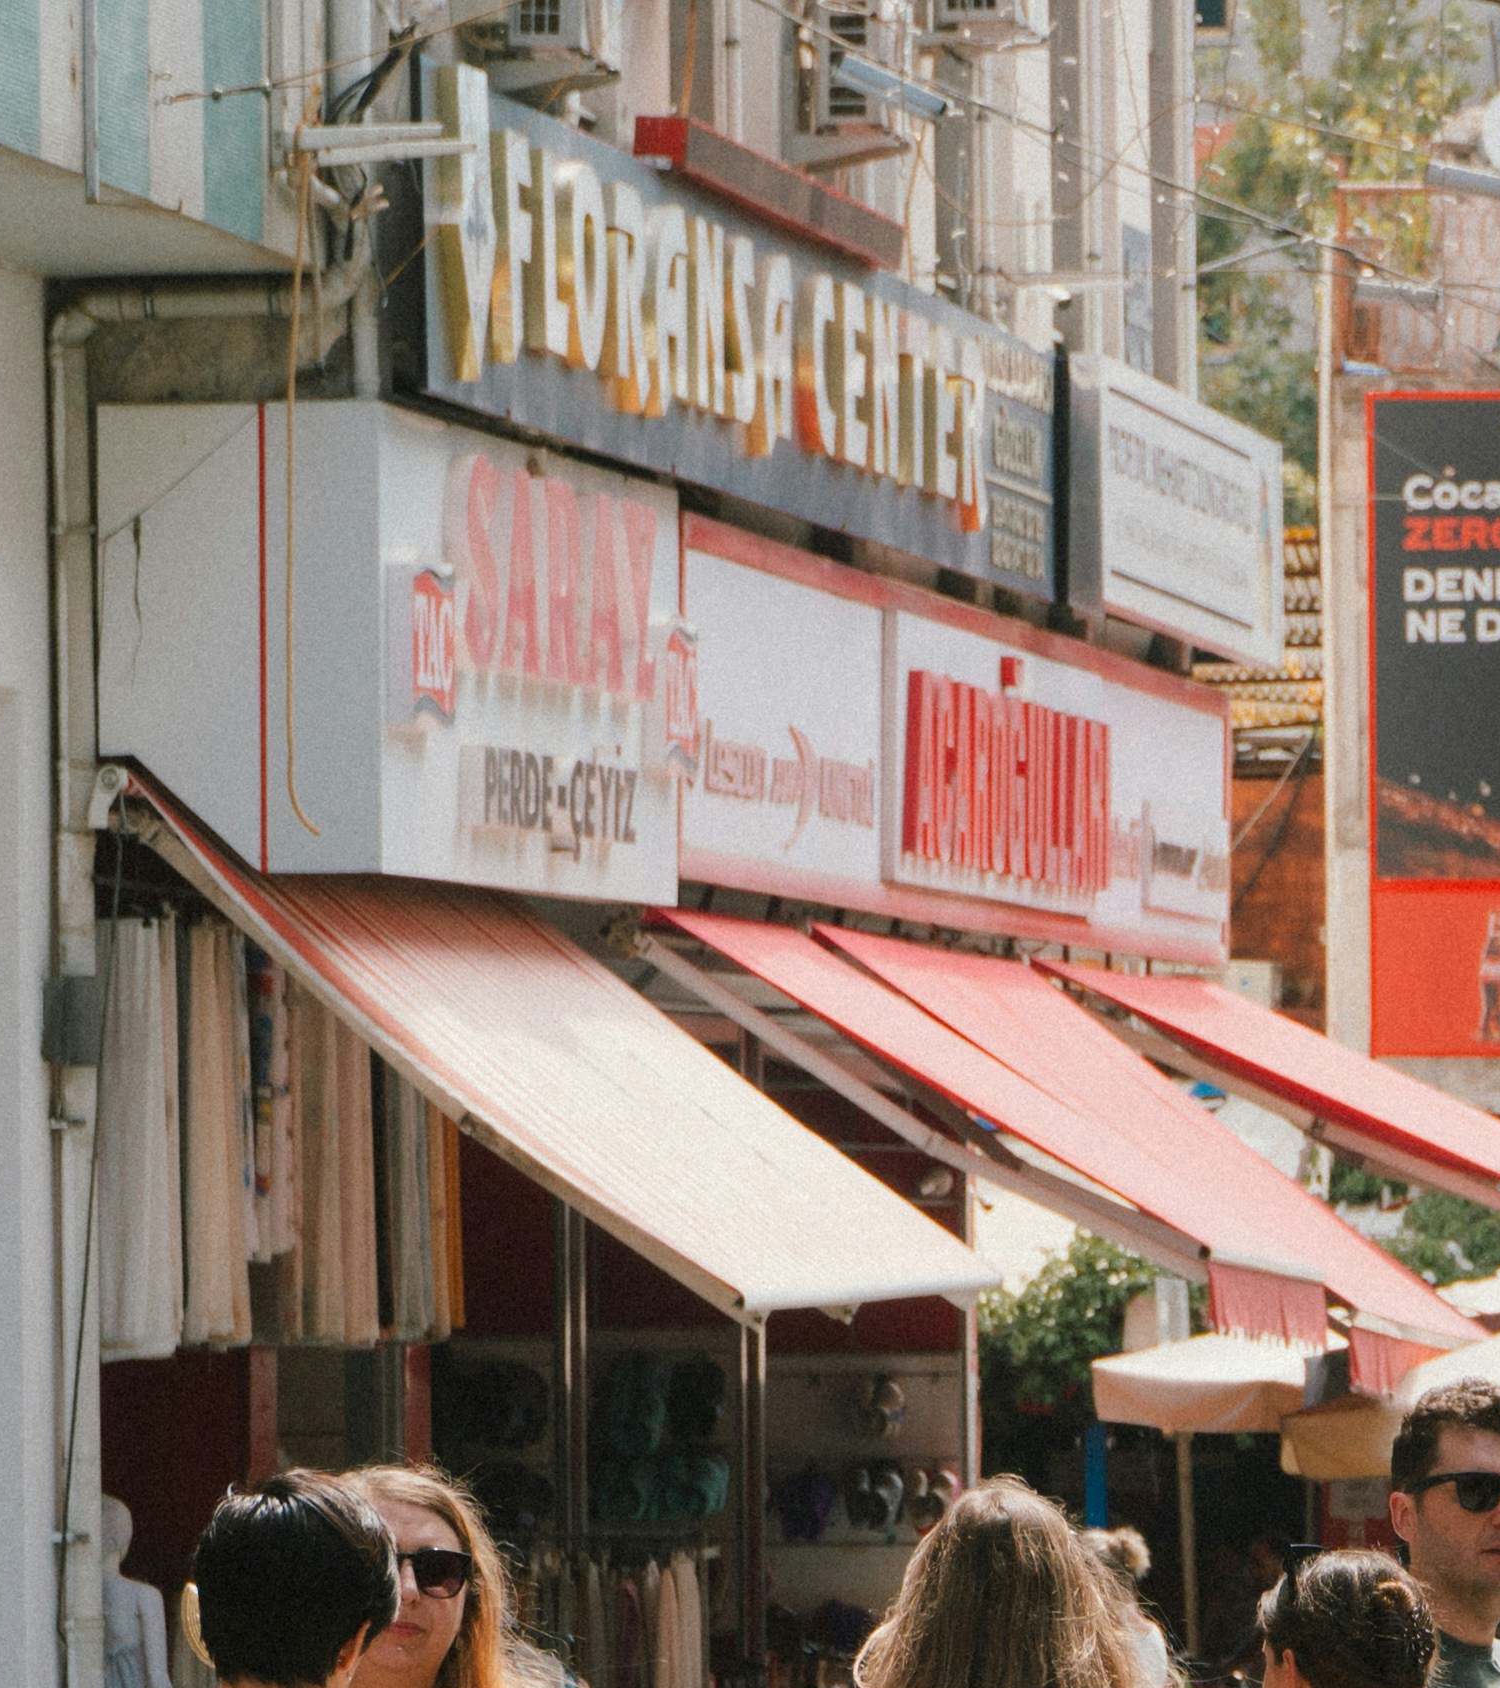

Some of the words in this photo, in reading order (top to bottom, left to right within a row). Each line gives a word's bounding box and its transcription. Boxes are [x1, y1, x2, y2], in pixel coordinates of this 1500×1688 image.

[800, 273, 988, 532] CENTER
[450, 454, 658, 700] SARAY
[1405, 611, 1466, 643] NE
